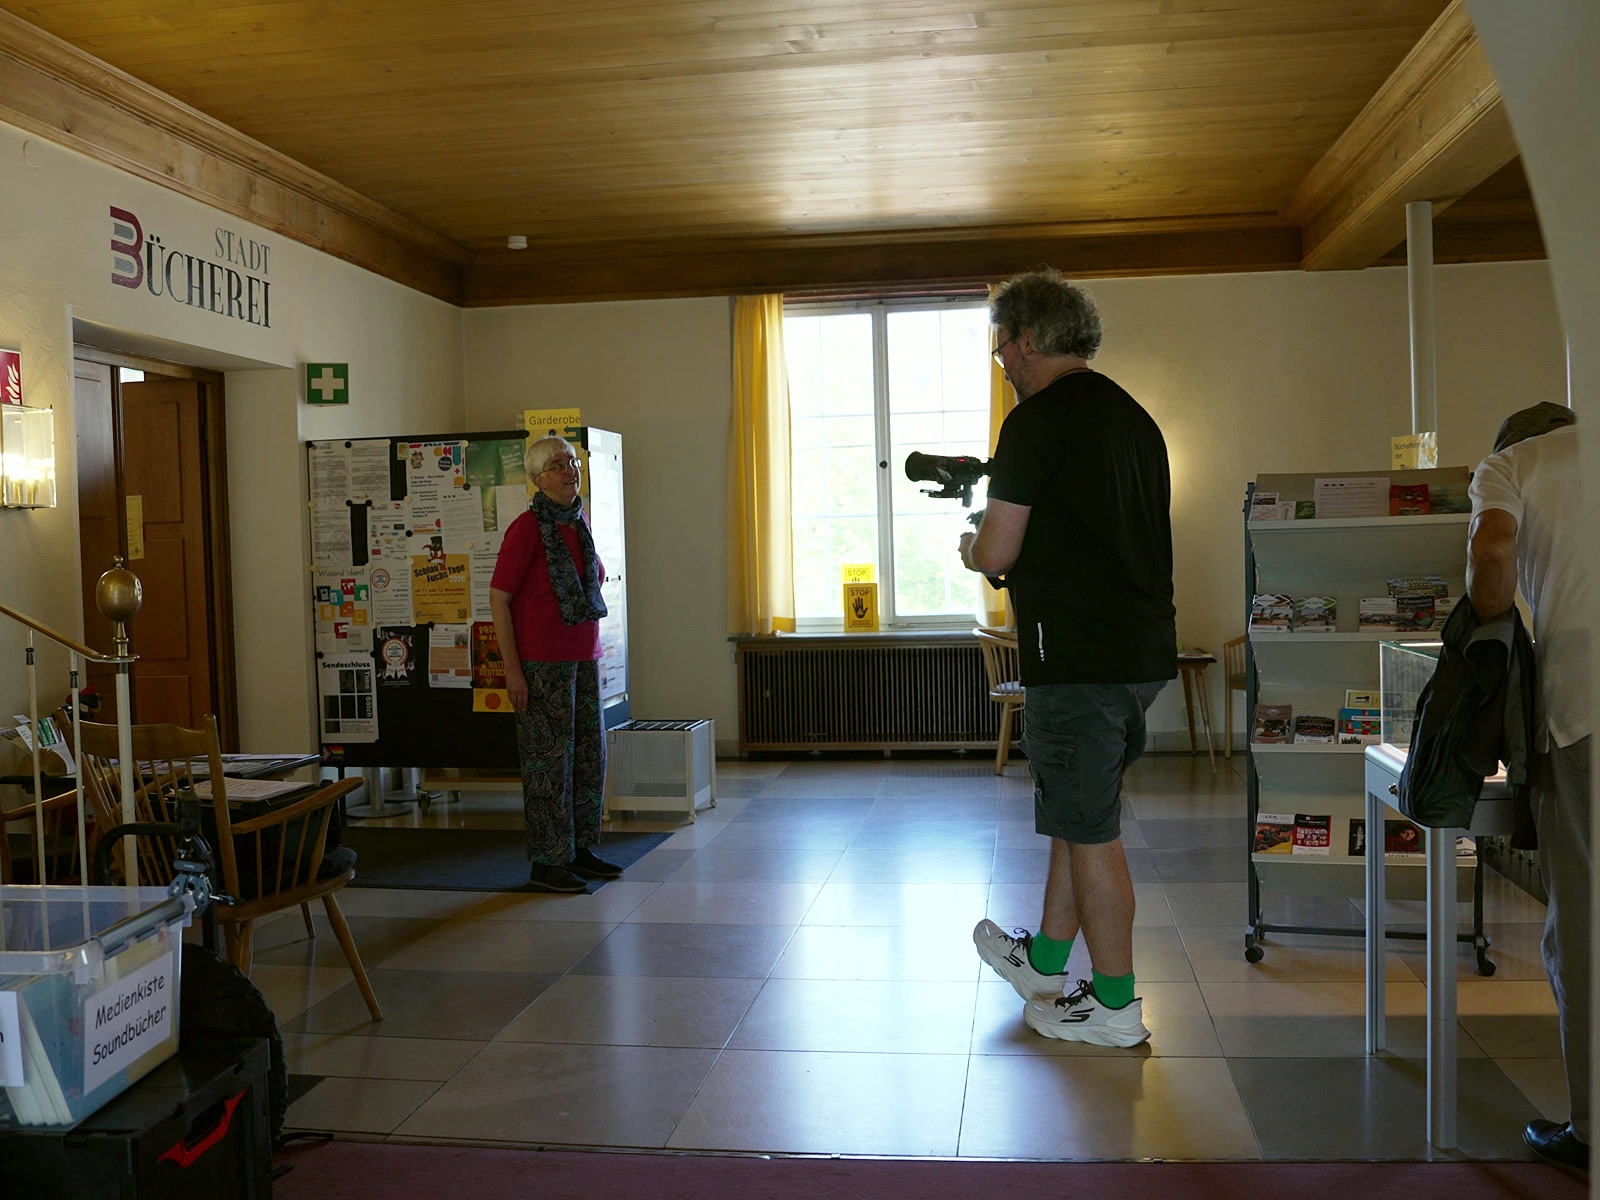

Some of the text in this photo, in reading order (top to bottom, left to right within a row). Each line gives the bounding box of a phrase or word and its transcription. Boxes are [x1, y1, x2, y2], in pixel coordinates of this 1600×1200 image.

[215, 227, 271, 275] STADT
[110, 205, 272, 329] BÜCHEREI
[529, 414, 581, 426] Garderobe
[318, 568, 365, 577] Wissenslcken?
[414, 564, 439, 577] Schlau
[447, 564, 466, 575] Tage
[847, 569, 867, 577] STOP
[427, 571, 448, 582] Fuchs
[850, 589, 870, 597] STOP
[479, 625, 494, 634] PRO
[322, 661, 371, 669] Sendeschluss
[479, 668, 505, 677] DEUTSC
[95, 975, 165, 1030] Medienkiste
[92, 1005, 167, 1065] Soundbücher
